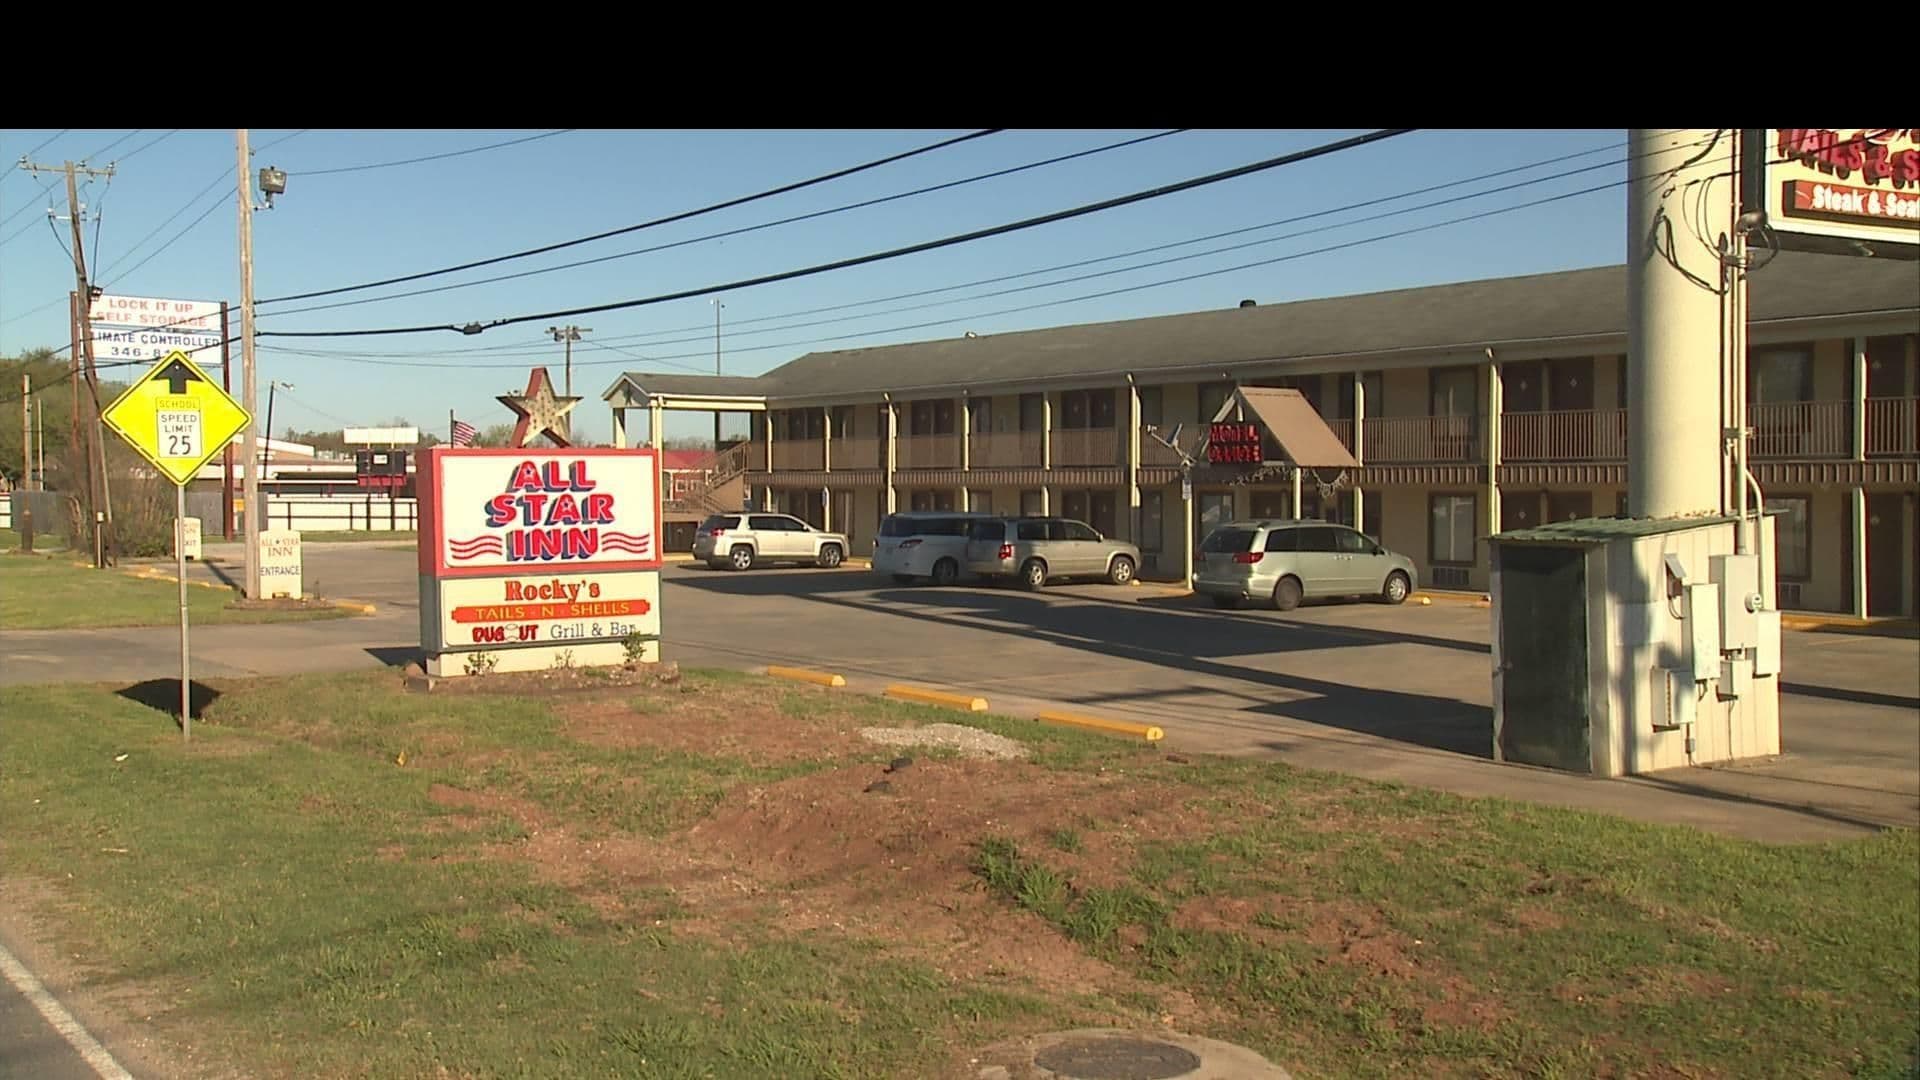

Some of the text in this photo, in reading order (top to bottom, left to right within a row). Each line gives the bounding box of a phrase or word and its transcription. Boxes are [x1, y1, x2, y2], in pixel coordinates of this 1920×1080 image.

[1813, 184, 1920, 218] Steak & Sea
[109, 298, 194, 313] LOCK IT UP
[96, 311, 208, 328] SELF STORAGE
[92, 330, 220, 348] IMATE CONTROLLED
[159, 399, 199, 409] SCHOOL
[161, 414, 198, 423] SPEED
[164, 424, 193, 433] LIMIT
[168, 435, 192, 455] 25
[505, 460, 597, 493] ALL
[484, 494, 616, 528] STAR
[268, 547, 293, 557] INN
[506, 527, 599, 561] INN
[260, 566, 300, 577] ENTRANCE
[504, 578, 601, 603] Rocky's
[475, 606, 526, 620] TAILS
[570, 602, 630, 616] SHELLS
[550, 623, 585, 639] Grill
[591, 622, 603, 637] &
[609, 620, 637, 637] Bar
